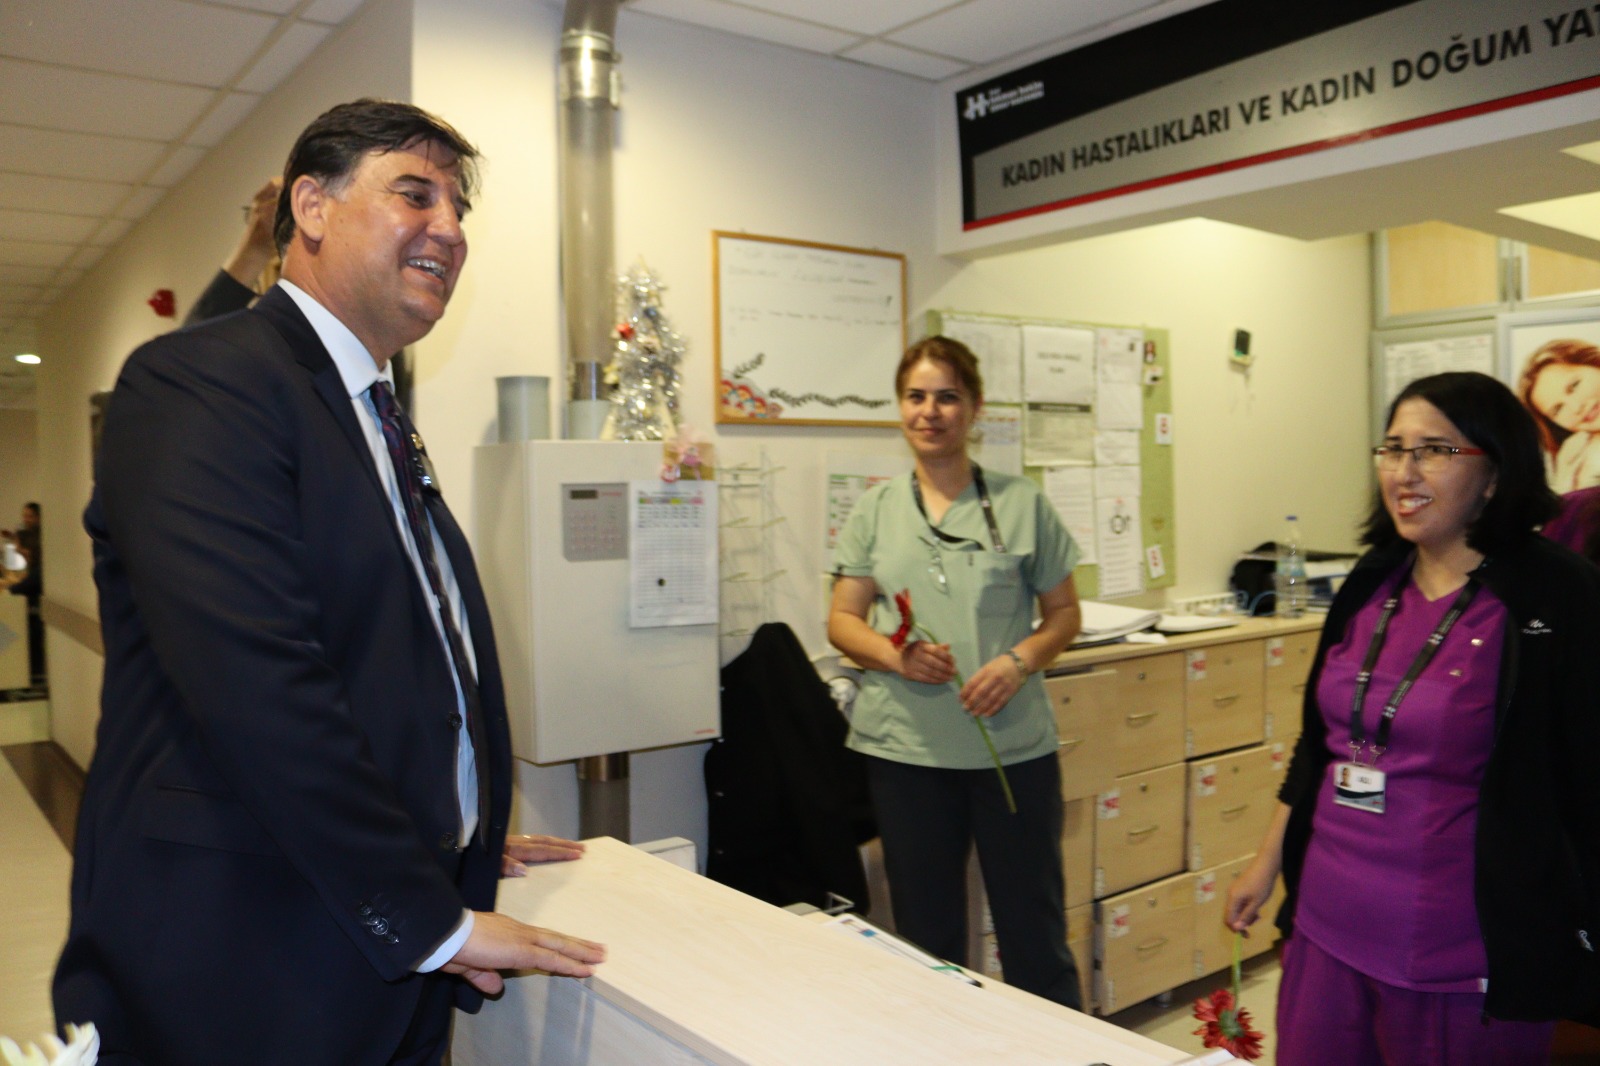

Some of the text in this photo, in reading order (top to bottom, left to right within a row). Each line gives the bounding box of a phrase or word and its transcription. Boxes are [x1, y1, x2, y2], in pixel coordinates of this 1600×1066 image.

[1001, 151, 1066, 188] KADIN
[1072, 106, 1230, 169] HASTALIKLARI
[1239, 94, 1271, 125] VE
[1281, 66, 1375, 116] KADIN
[1392, 24, 1532, 88] DOĞUM
